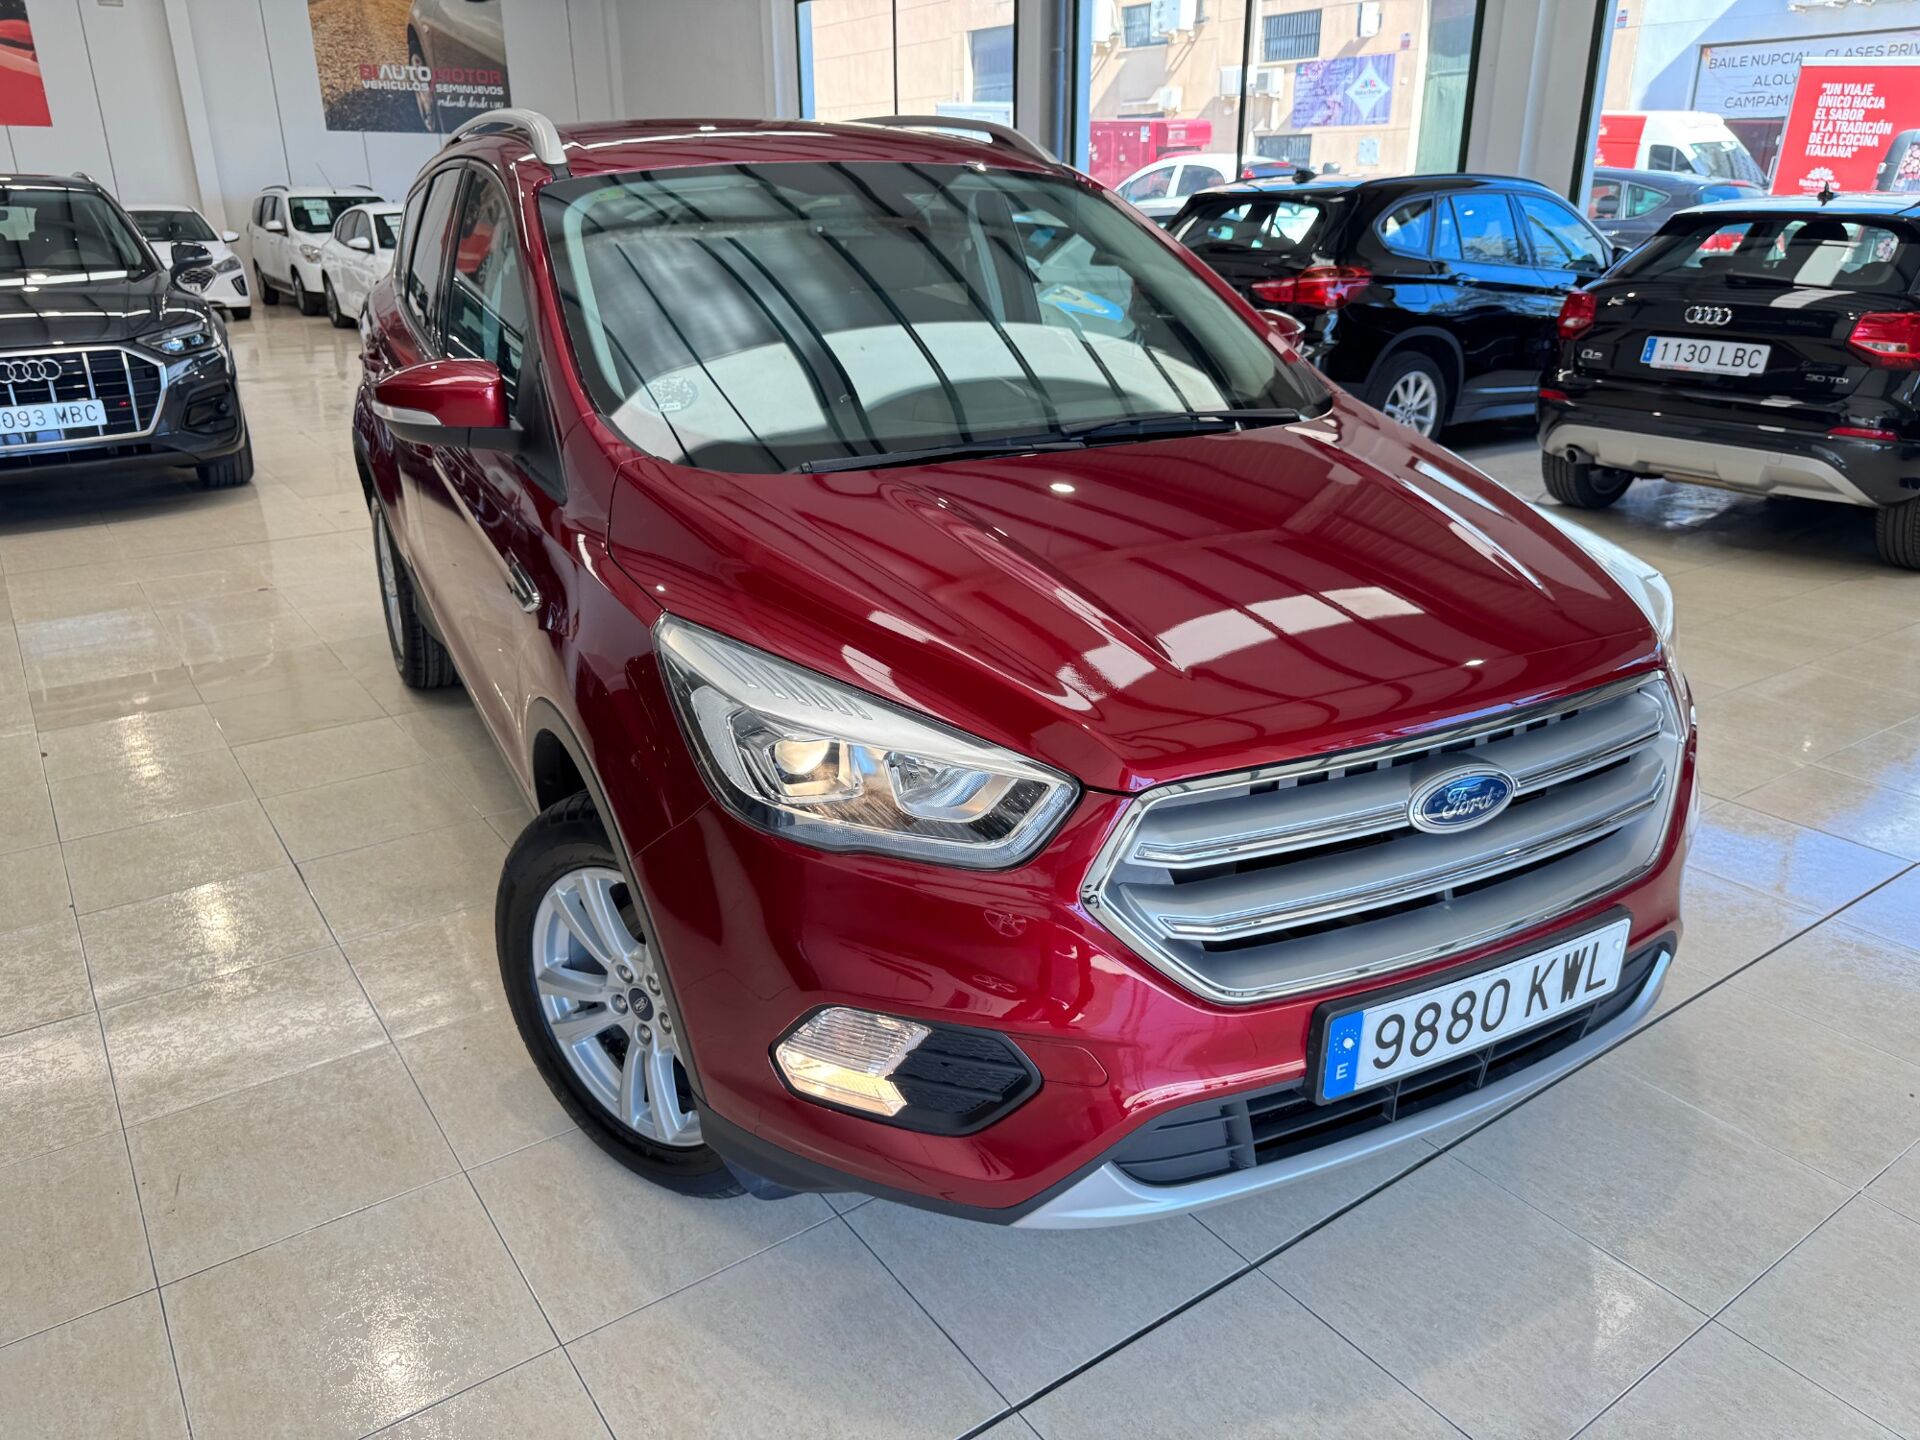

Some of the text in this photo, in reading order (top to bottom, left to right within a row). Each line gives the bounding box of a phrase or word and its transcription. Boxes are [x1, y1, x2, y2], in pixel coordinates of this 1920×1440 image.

[1709, 55, 1748, 69] BAILE
[362, 80, 504, 95] VEHICULOS SEMINUEVOS
[1843, 83, 1876, 95] VIAJE
[1852, 96, 1886, 109] HACIA
[1814, 107, 1866, 121] EL SABOR
[1811, 119, 1893, 135] Y LA TRADICIÓN
[1808, 132, 1879, 147] DE LA COCINA
[1661, 342, 1762, 369] 1130 LBC
[53, 404, 98, 424] MBC
[1441, 783, 1495, 819] Ford
[1372, 942, 1607, 1071] 9880 KWL
[1335, 1062, 1350, 1081] E
